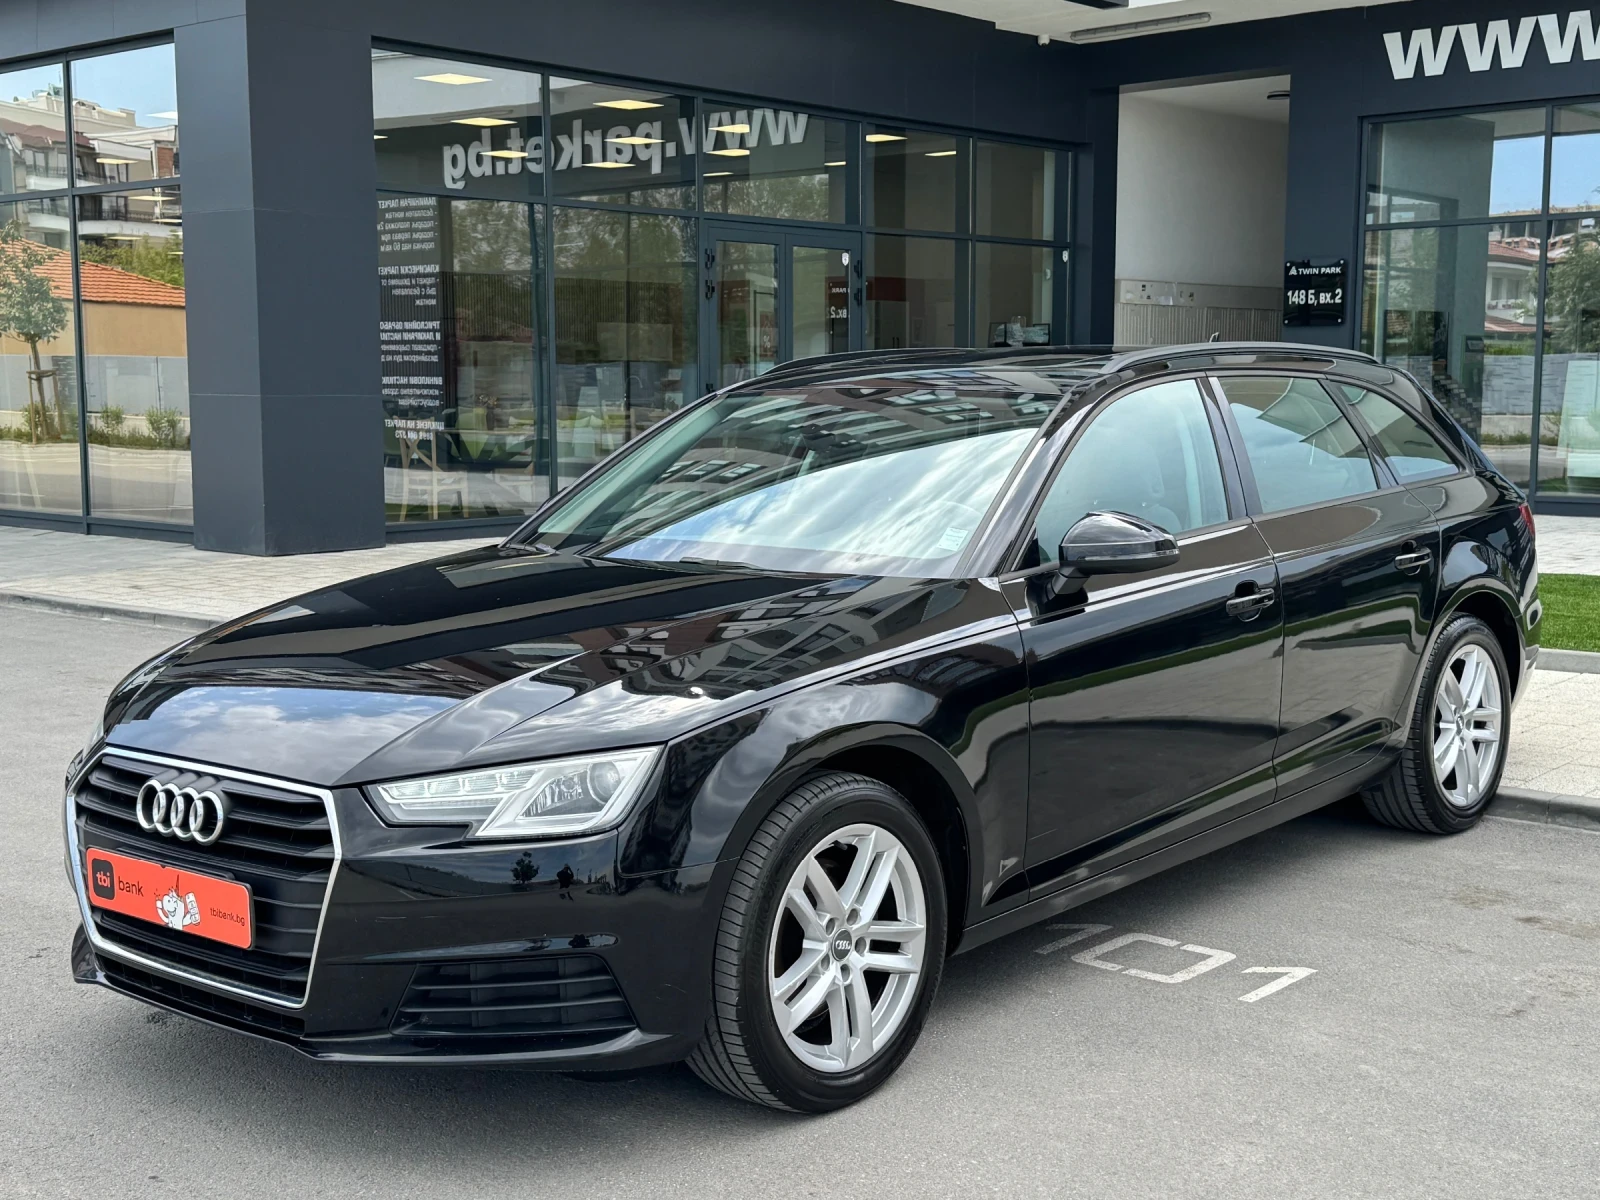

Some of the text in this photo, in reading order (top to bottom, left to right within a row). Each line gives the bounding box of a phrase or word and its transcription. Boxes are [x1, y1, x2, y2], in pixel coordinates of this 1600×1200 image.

[1298, 266, 1342, 275] TWIN PARK
[1287, 289, 1306, 305] 148
[1307, 289, 1317, 306] Б,
[1334, 288, 1342, 304] 2
[96, 871, 111, 888] tbi
[118, 876, 144, 897] bank
[209, 907, 245, 927] tbibank.bg
